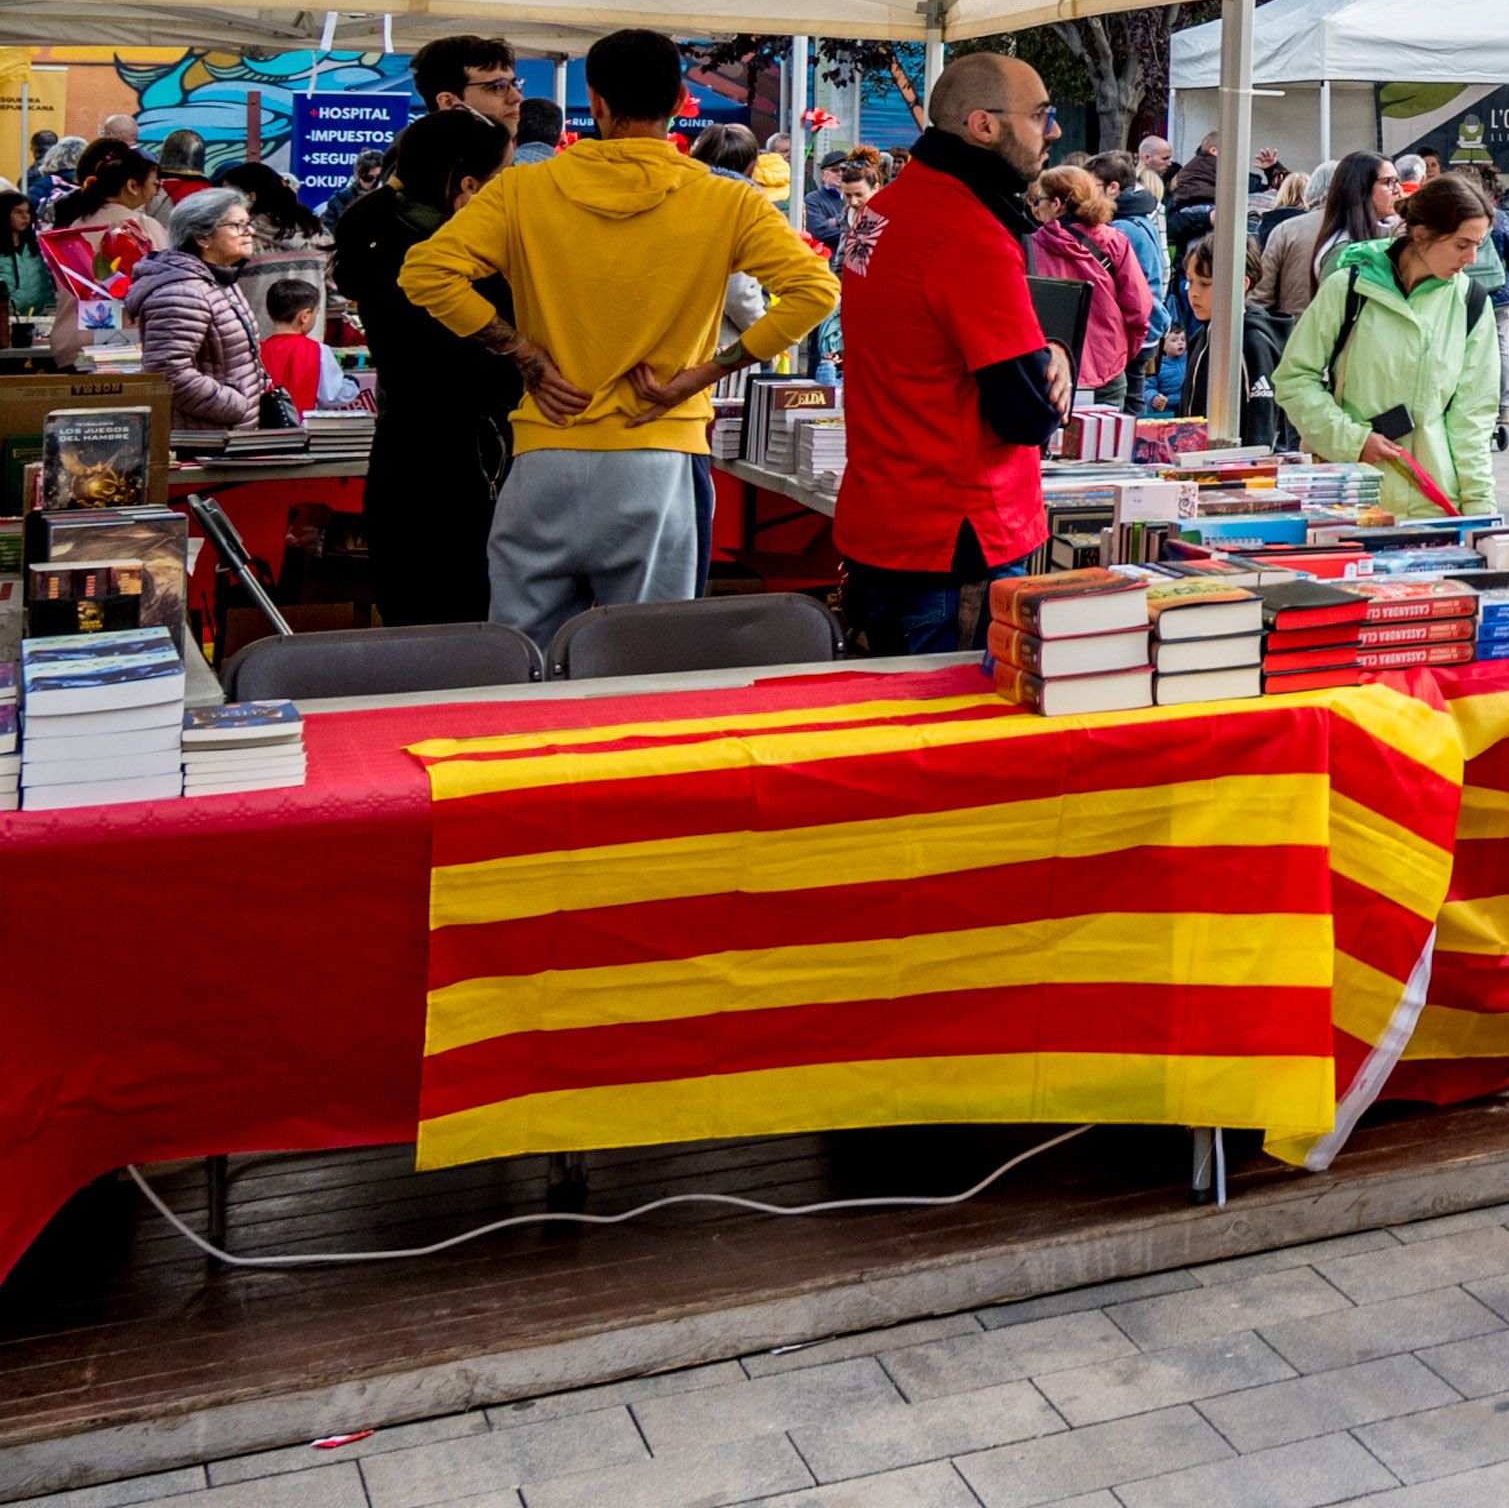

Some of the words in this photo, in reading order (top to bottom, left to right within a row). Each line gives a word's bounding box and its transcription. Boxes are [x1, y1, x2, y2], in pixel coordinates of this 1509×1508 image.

[784, 391, 827, 409] ZELDA
[59, 427, 81, 435] LOS
[84, 426, 130, 434] JUEGOS
[59, 435, 80, 443] DEL
[83, 433, 130, 441] HAMBRE
[1382, 604, 1430, 618] CASSANDRA
[1379, 628, 1427, 641] CASSANDRA
[1379, 650, 1427, 664] CASSANDRA
